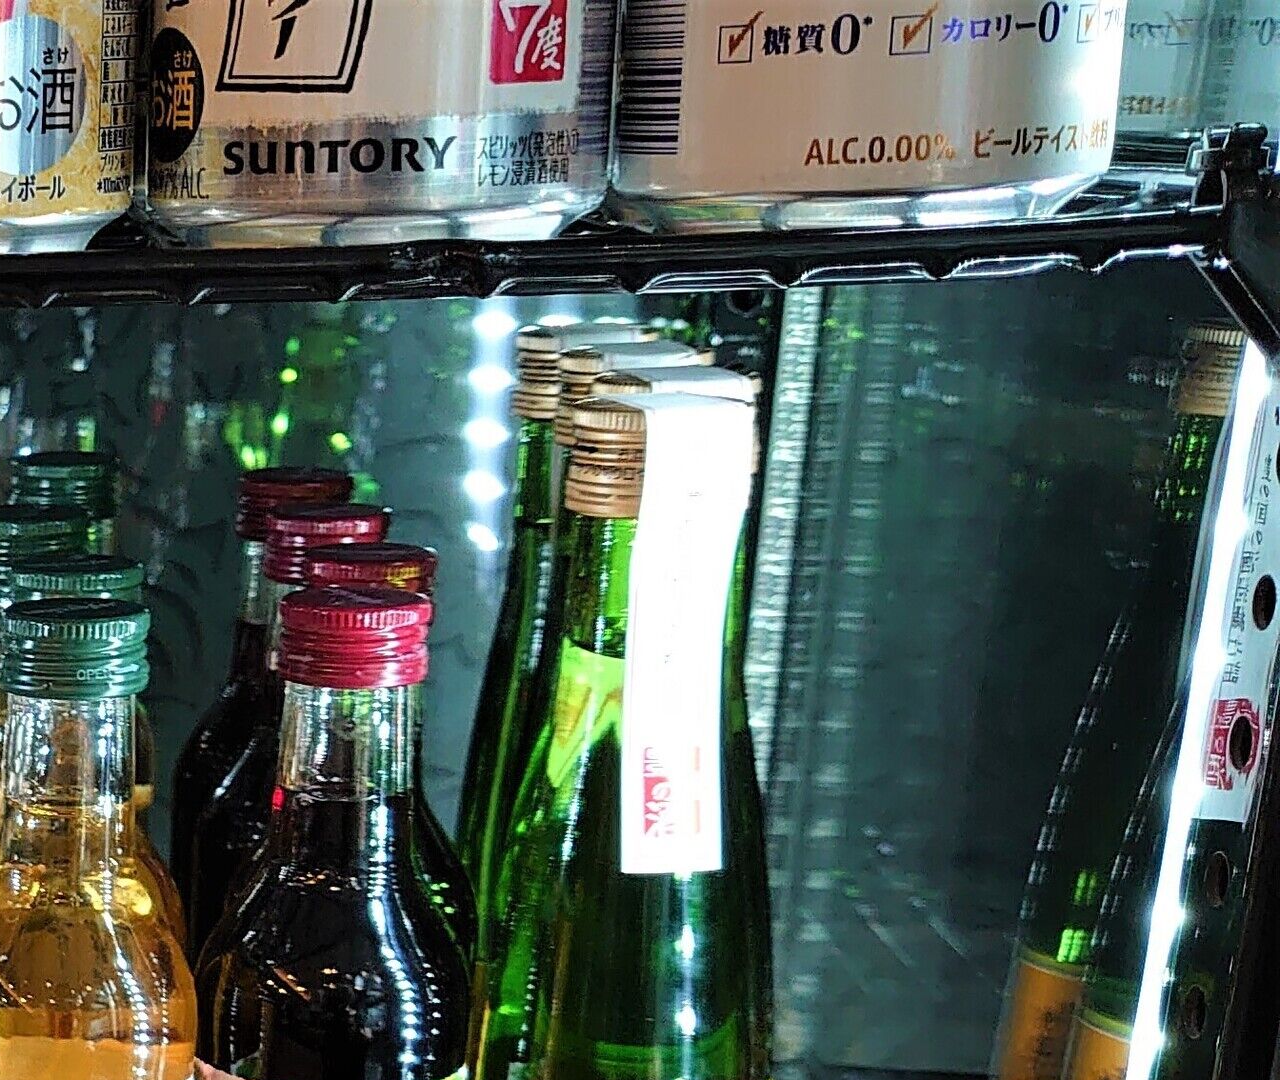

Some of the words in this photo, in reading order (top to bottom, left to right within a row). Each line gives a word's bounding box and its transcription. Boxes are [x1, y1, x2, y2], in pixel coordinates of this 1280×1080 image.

[43, 48, 69, 64] さけ
[173, 51, 192, 68] さけ
[223, 136, 456, 175] SUNTORY
[803, 133, 956, 167] ALC.0.00%
